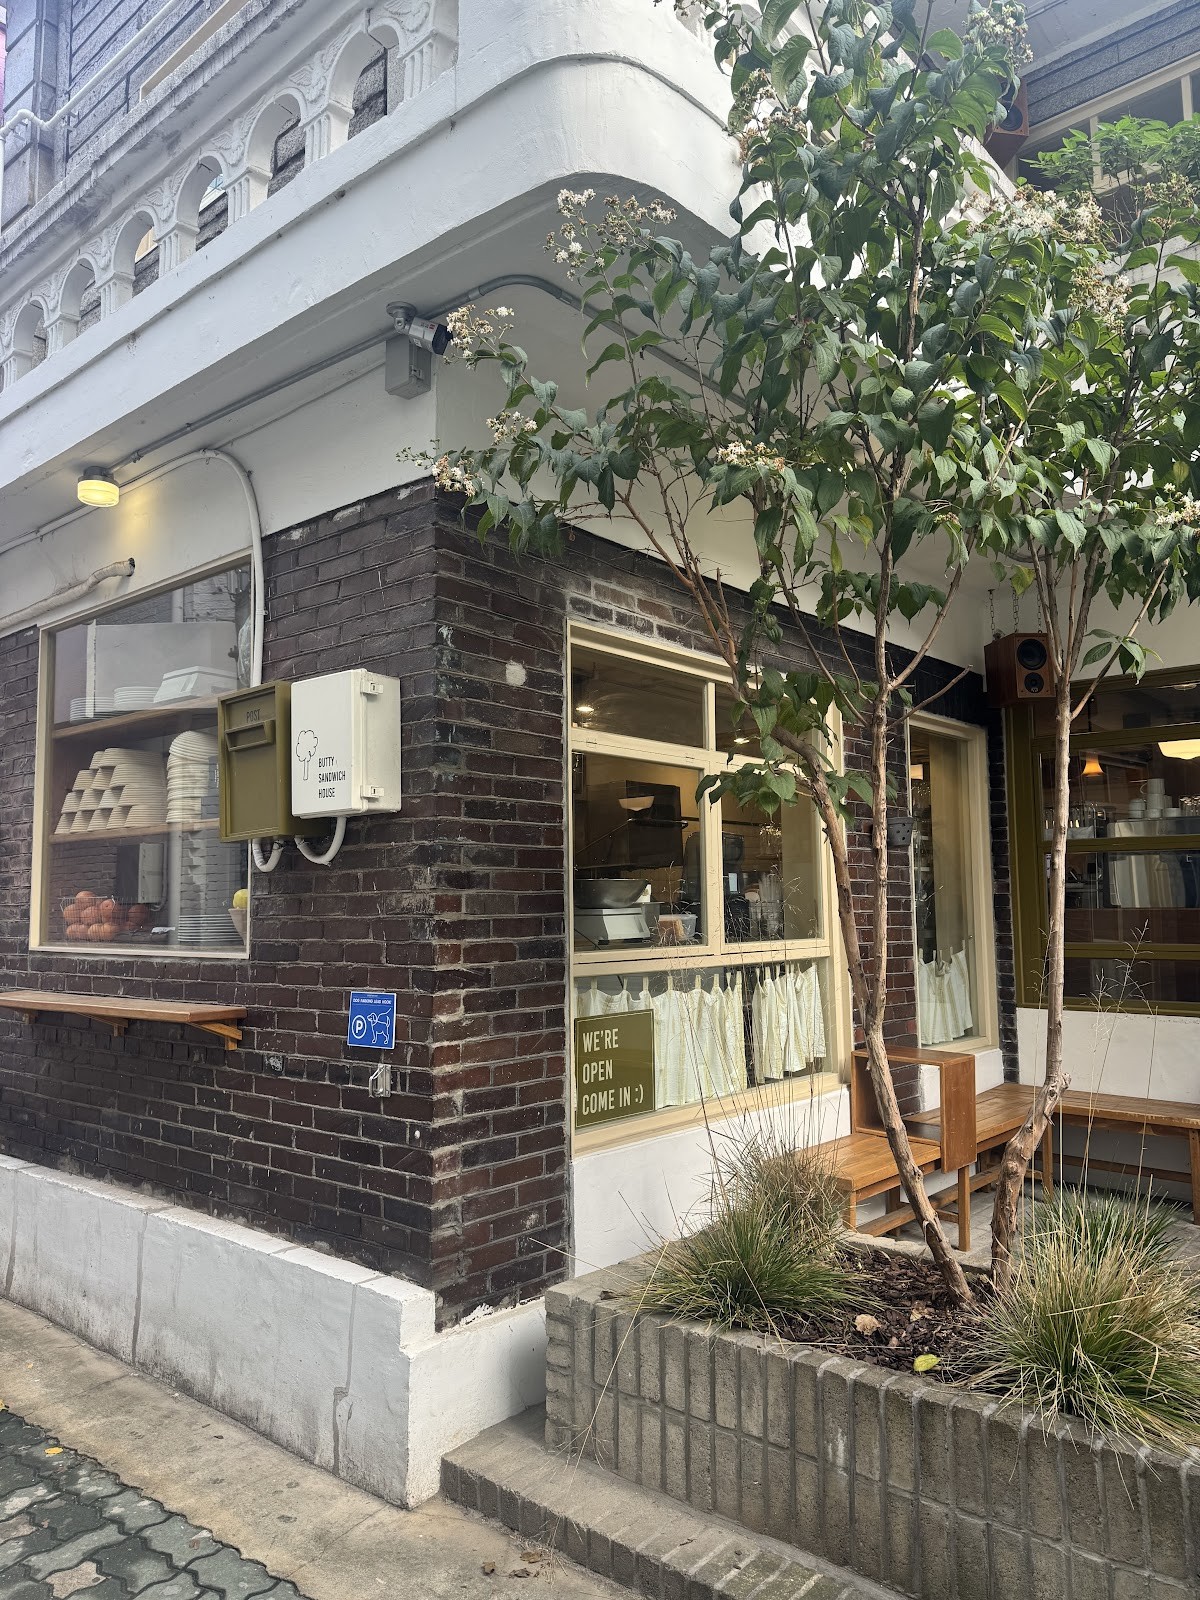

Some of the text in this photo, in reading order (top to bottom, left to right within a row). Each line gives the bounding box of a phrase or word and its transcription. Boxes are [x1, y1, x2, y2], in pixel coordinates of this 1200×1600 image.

[246, 709, 260, 723] POST
[318, 756, 334, 767] BUTTY
[318, 770, 346, 783] SANDWICH
[318, 787, 335, 798] HOUSE
[355, 1020, 363, 1034] P
[582, 1028, 619, 1053] WE'RE
[582, 1059, 613, 1084] OPEN
[582, 1089, 615, 1115] COME
[619, 1086, 631, 1108] IN
